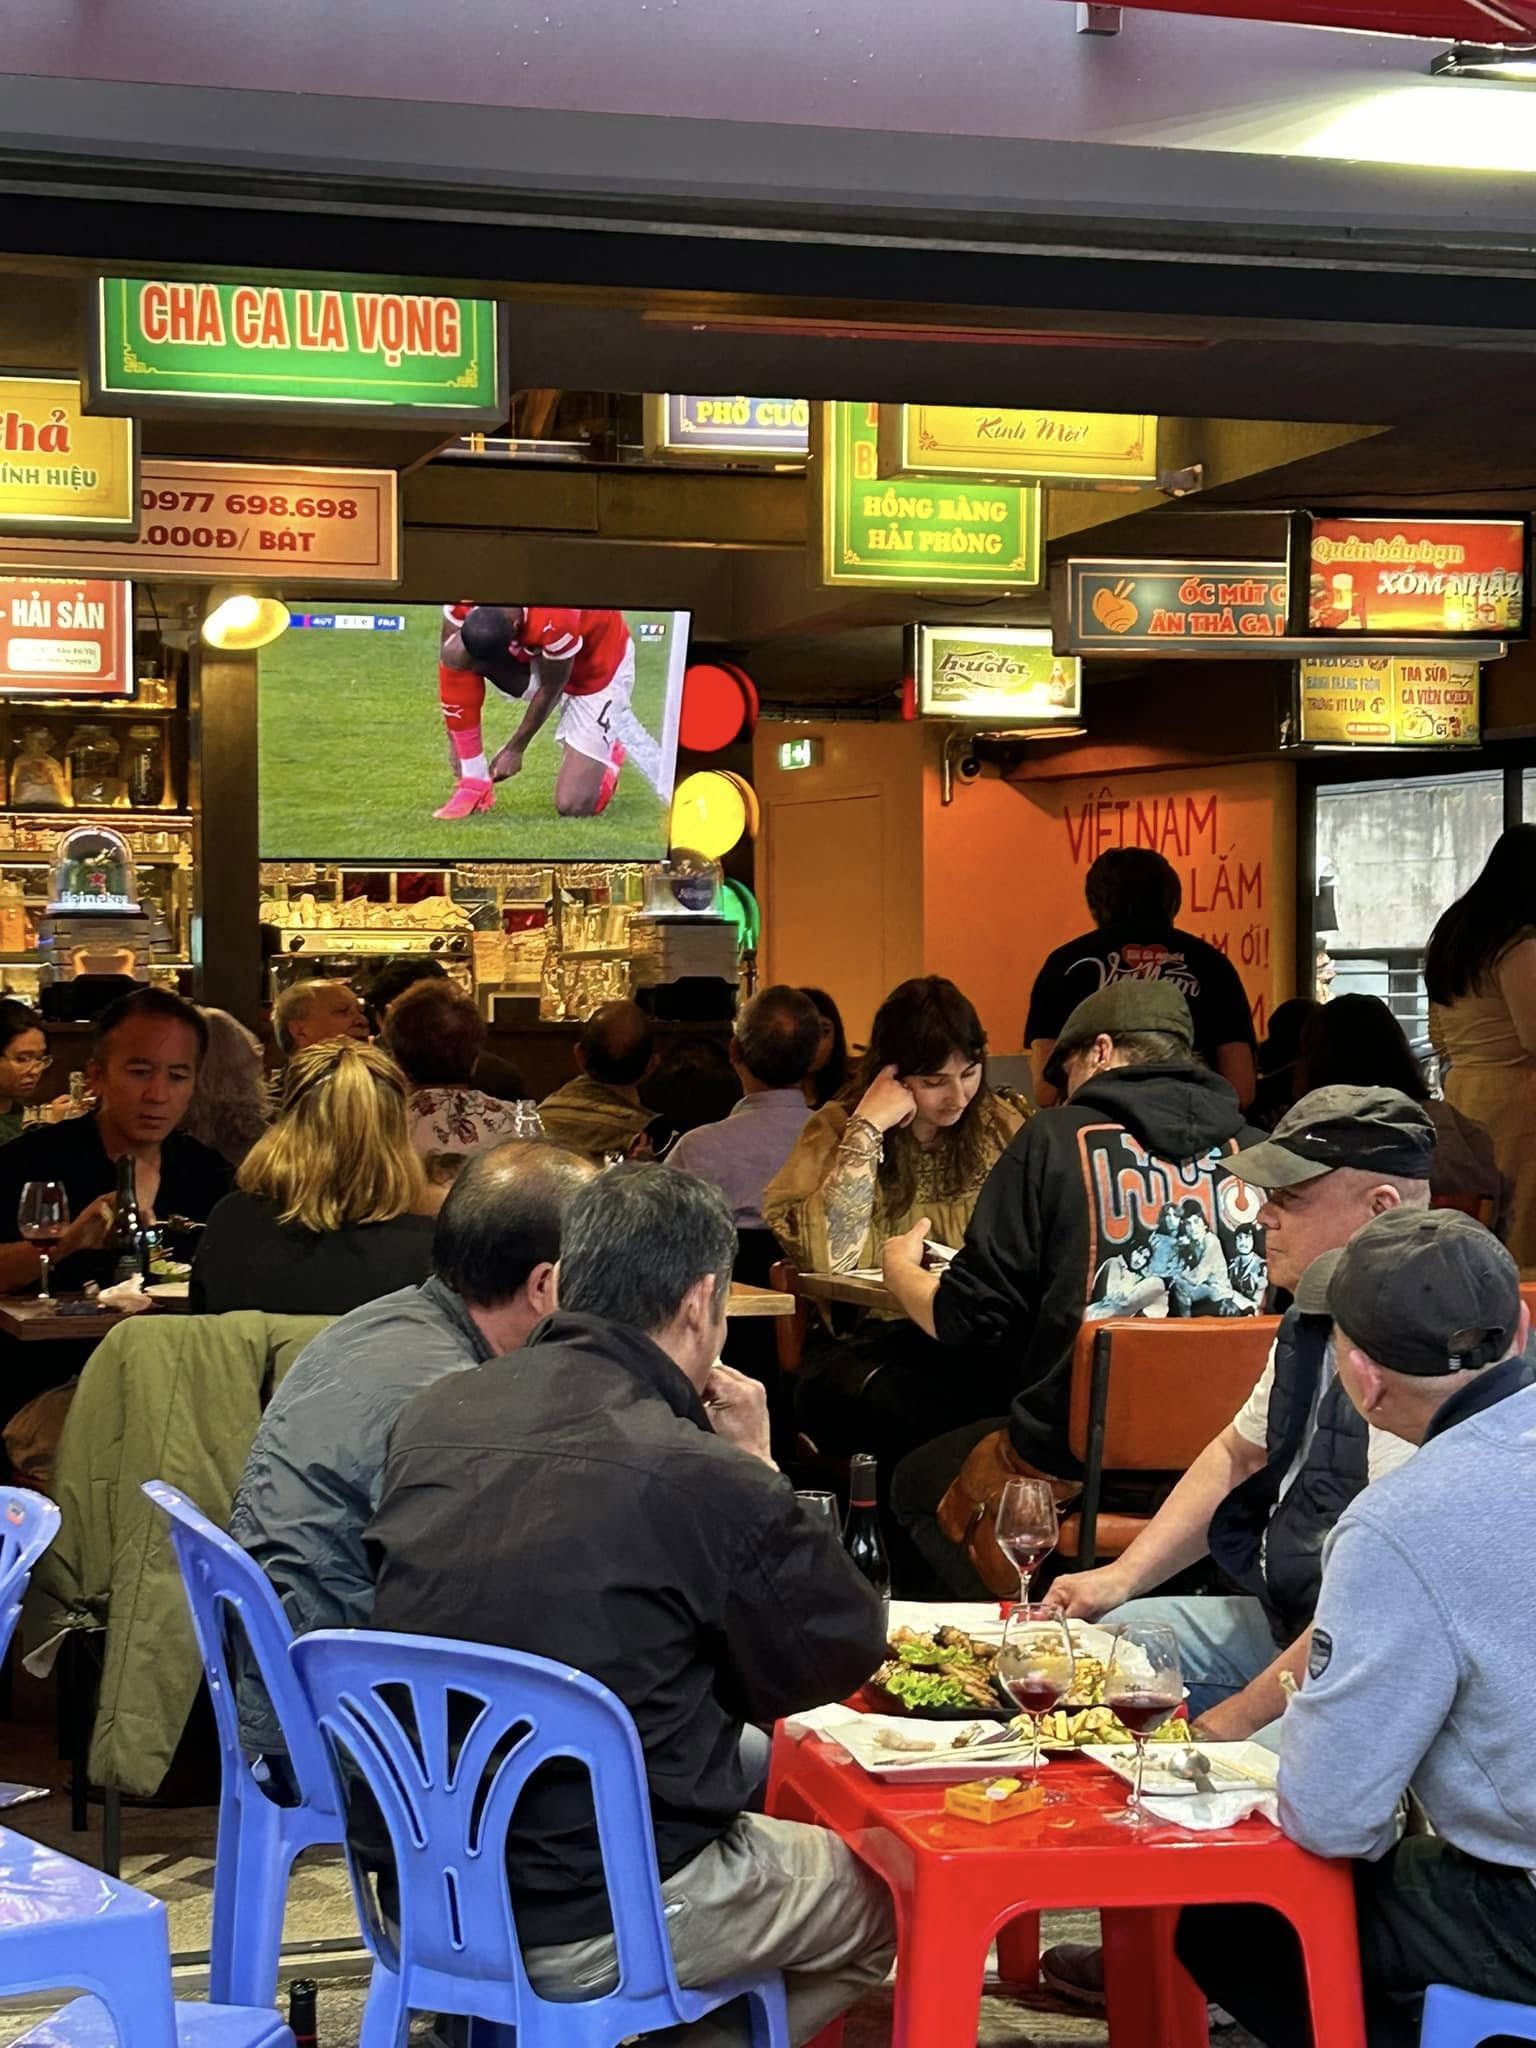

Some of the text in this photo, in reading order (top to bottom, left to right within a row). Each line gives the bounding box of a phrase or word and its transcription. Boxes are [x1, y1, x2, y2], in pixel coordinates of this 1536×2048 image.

[353, 294, 461, 367] VỌNG
[0, 409, 71, 453] hả
[46, 466, 97, 491] HIỆU
[140, 490, 358, 519] 0977 698.698
[867, 522, 1003, 554] HẢI PHÒNG
[1377, 566, 1444, 595] XÓM
[12, 590, 51, 628] HẢI
[57, 592, 105, 630] SẢN
[597, 700, 612, 733] 4
[1191, 843, 1262, 913] LẮM
